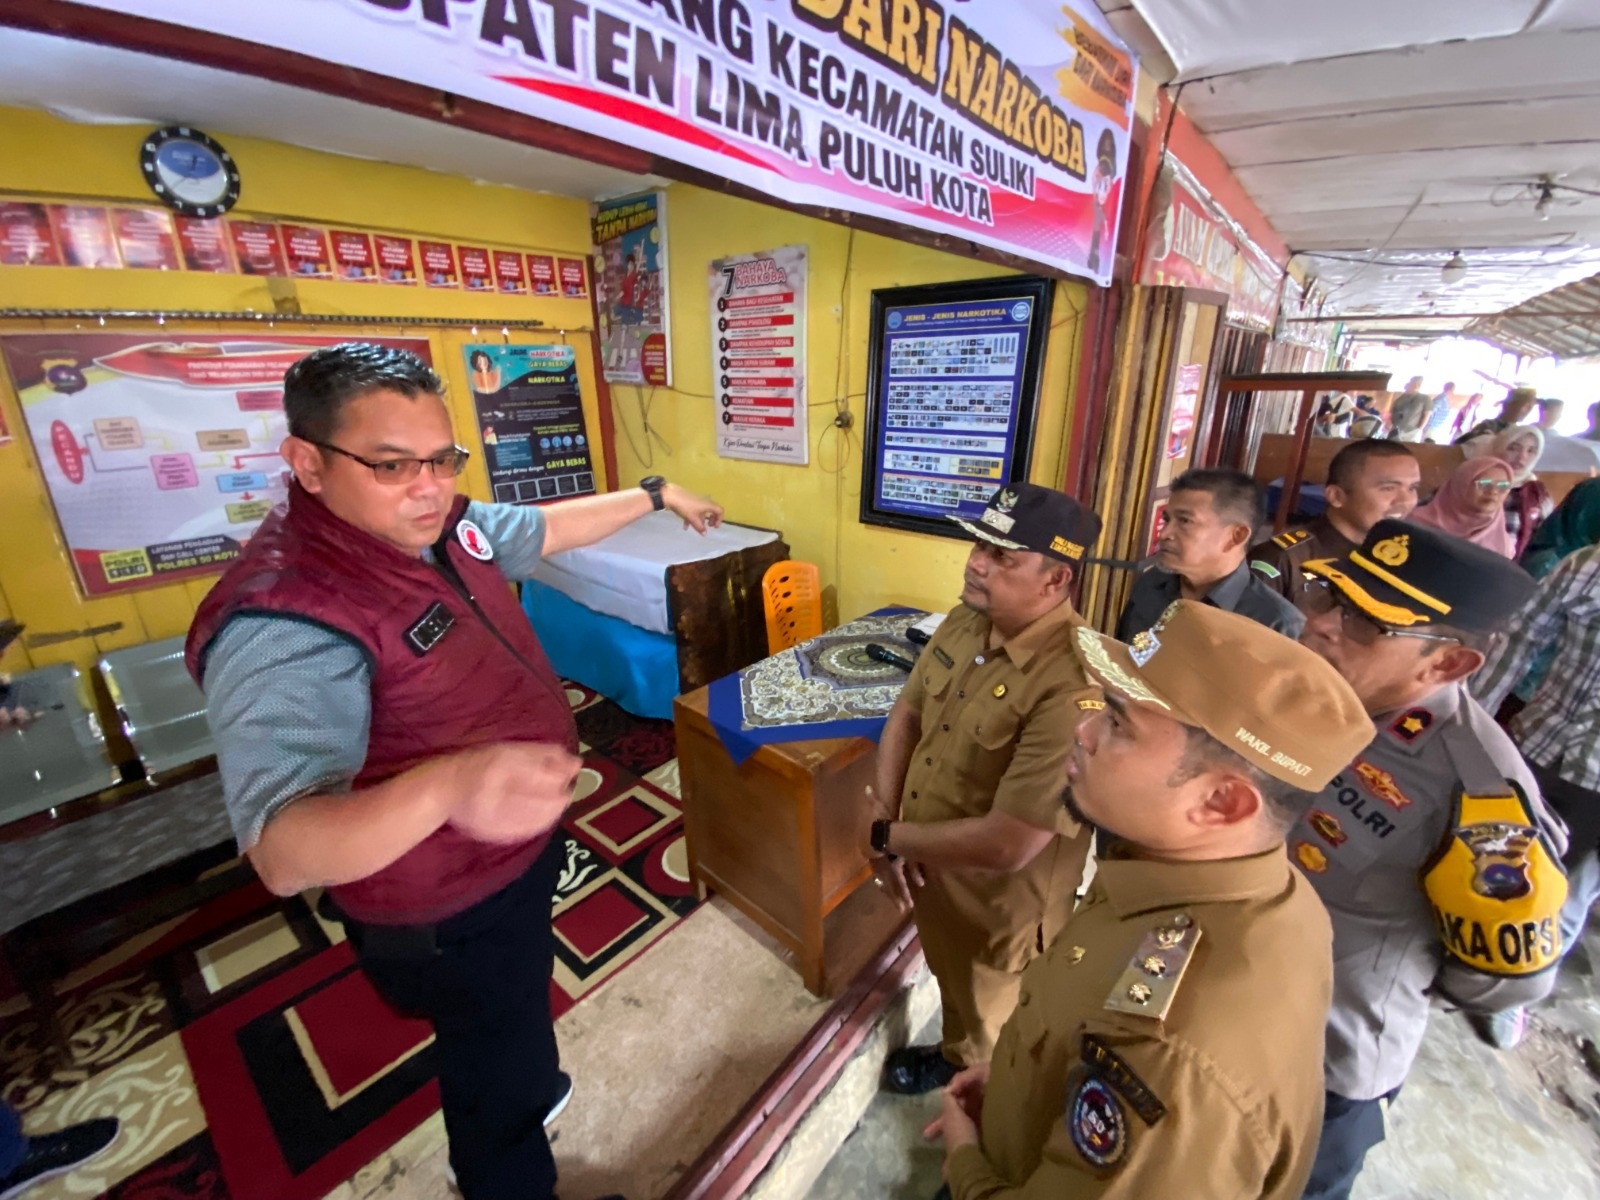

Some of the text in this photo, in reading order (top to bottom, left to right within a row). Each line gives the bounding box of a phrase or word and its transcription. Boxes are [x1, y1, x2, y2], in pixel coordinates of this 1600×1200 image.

[635, 0, 1035, 198] NG KECAMATAN SULIKI
[797, 0, 942, 86] ARI
[944, 26, 1088, 178] NARKOBA
[363, 0, 993, 224] ATEN LIMA PULUH KOTA
[723, 259, 776, 295] 7 BAHAYA
[735, 268, 786, 287] NARKOBA
[904, 314, 926, 322] JENIS
[932, 312, 955, 320] JENIS
[957, 308, 1007, 319] NARKOTIKA
[528, 376, 565, 384] NARKOTIKA
[546, 459, 565, 470] GAYA
[566, 457, 586, 467] BEBAS
[156, 557, 198, 571] POLRES
[214, 550, 240, 561] KOTA
[1234, 726, 1272, 757] WAKIL
[1497, 917, 1555, 965] OPS
